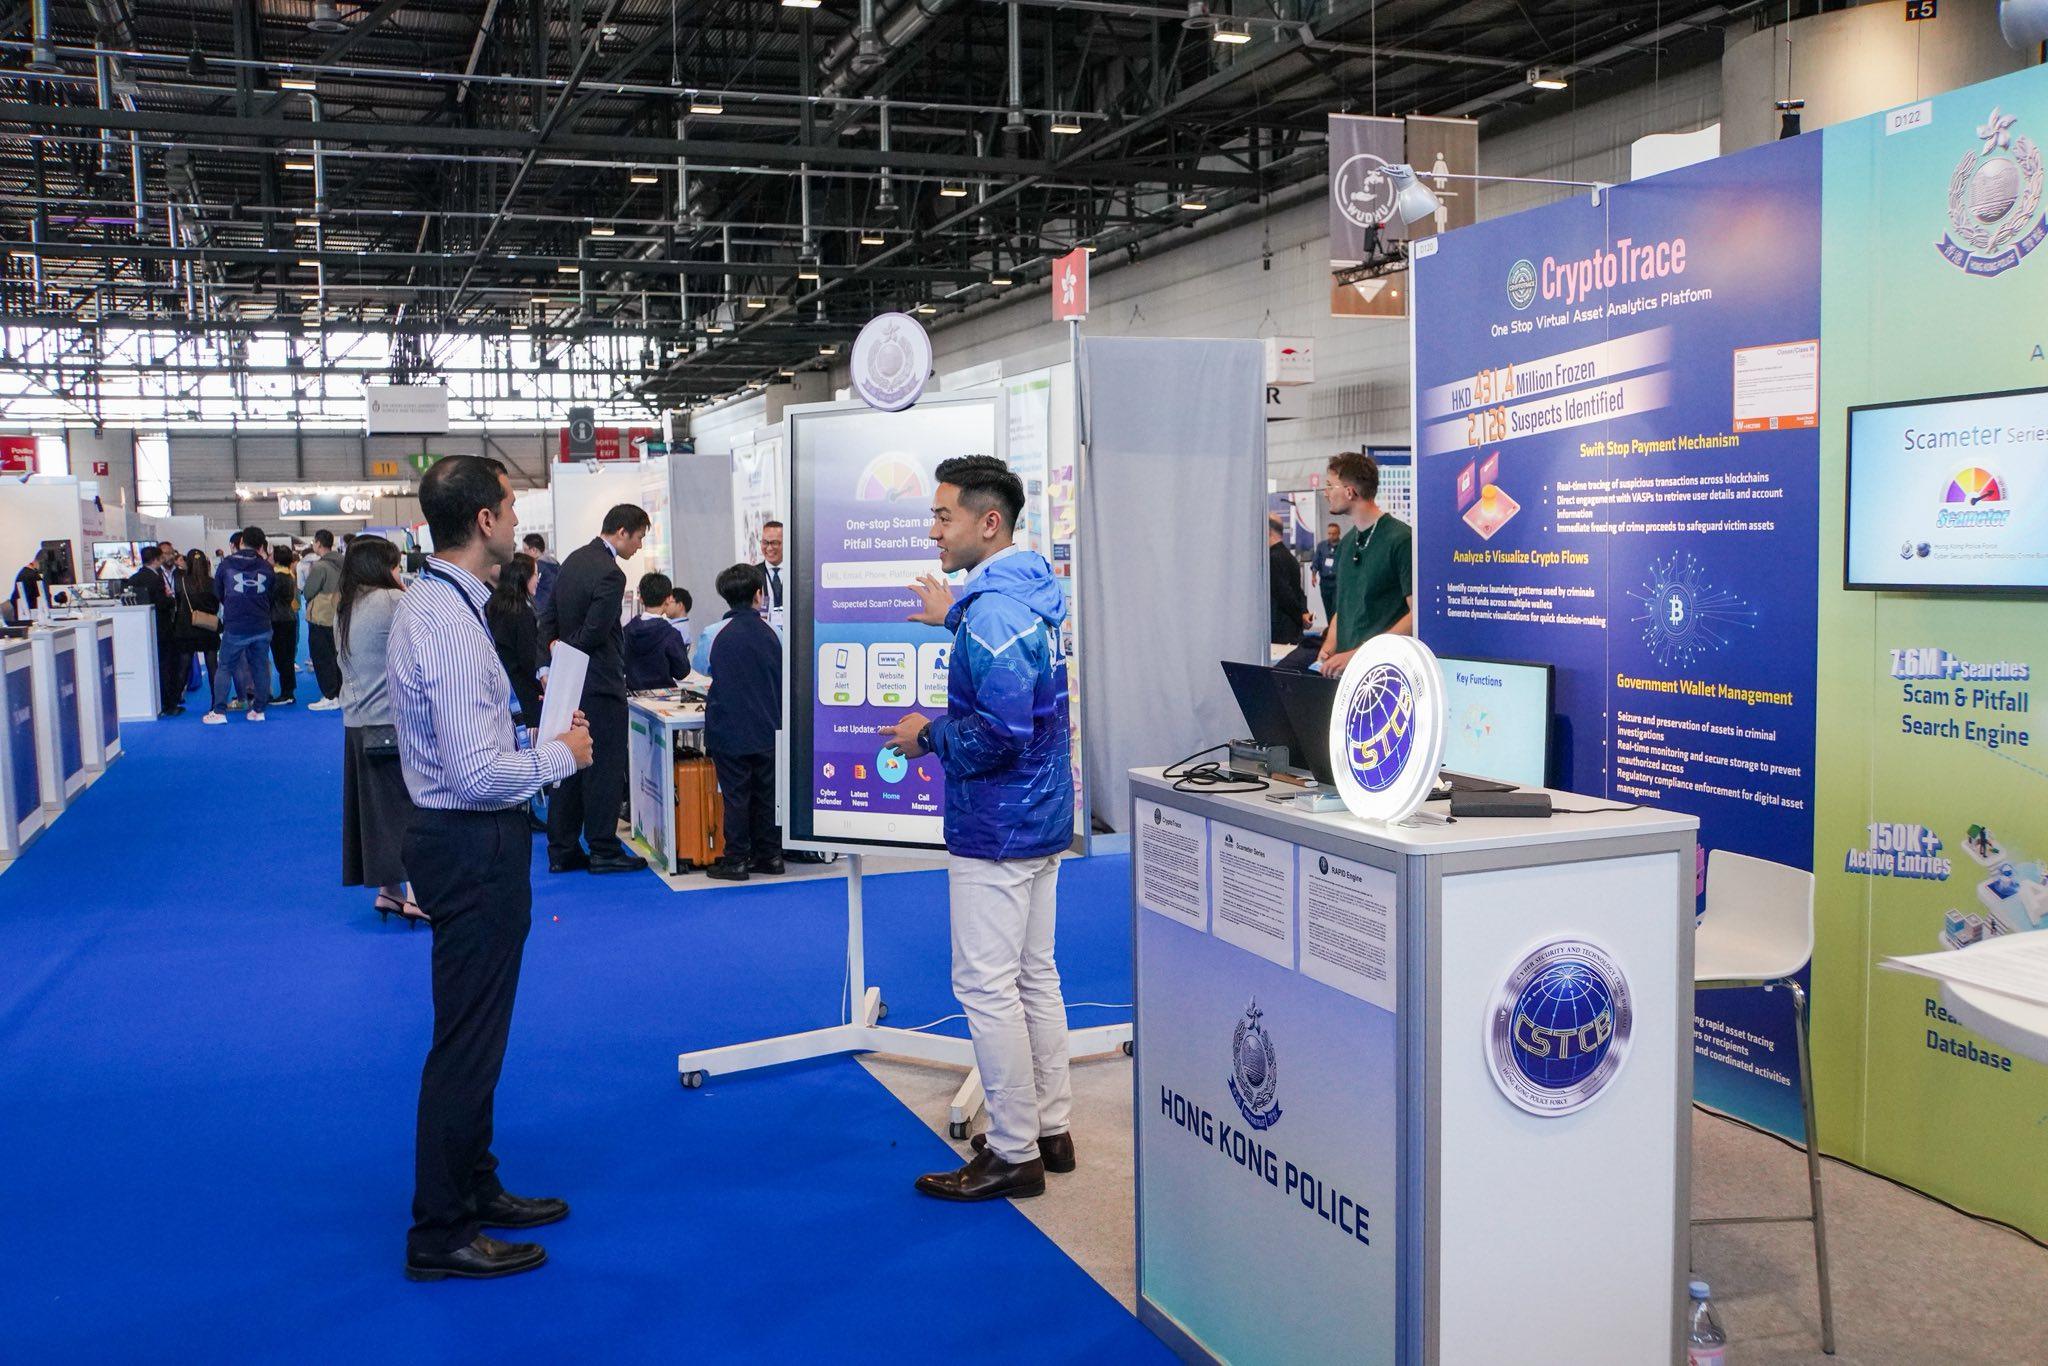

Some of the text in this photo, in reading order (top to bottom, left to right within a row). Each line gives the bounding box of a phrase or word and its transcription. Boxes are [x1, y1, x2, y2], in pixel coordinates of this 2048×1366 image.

[1895, 110, 1921, 128] D122
[1347, 203, 1389, 223] WUDHU
[1541, 238, 1686, 306] CryptoTrace
[1491, 286, 1712, 338] One Stop Virtual Asset Analytics Platform
[2030, 344, 2045, 362] A
[1452, 361, 1596, 411] HKD 431.4 Million Frozen
[1466, 387, 1624, 449] 2,128 Suspects Identified
[1580, 432, 1740, 458] Swift Stop Payment Mechanism
[1904, 424, 2002, 451] Scameter
[97, 463, 105, 473] F
[380, 463, 391, 473] 11
[1557, 472, 1769, 491] Real-time tracing of suspicious transactions across blockchains
[1557, 488, 1783, 505] Direct with VASPs to retrieve user details and account
[1557, 508, 1593, 518] information
[846, 517, 936, 531] One-stop Scam an
[1626, 520, 1775, 534] crime proceeds to safeguard victim assets
[843, 536, 938, 550] Pitfall Search Engin
[1453, 549, 1589, 567] Analyze Visualize Crypto Flows
[1543, 586, 1595, 598] used by criminals
[832, 599, 922, 610] Suspected Scam? Check It
[1490, 599, 1553, 609] across wallets
[1540, 613, 1607, 629] quick decision-making
[835, 671, 848, 679] Call
[879, 672, 905, 680] Website
[1960, 660, 2030, 681] Searches
[834, 682, 850, 690] Alert
[876, 682, 907, 690] Detection
[1456, 672, 1503, 688] Key Functions
[1617, 673, 1793, 706] Government Wallet Management
[1903, 683, 2029, 713] Scam & Pitfall
[833, 725, 849, 733] Last
[849, 725, 876, 734] Update:
[1617, 711, 1776, 741] Seizure and preservation of assets in criminal
[1617, 725, 1664, 741] investigations
[1902, 714, 2029, 748] Search Engine
[1617, 739, 1801, 777] Real-time monitoring and secure storage to prevent
[1617, 755, 1684, 774] unauthorized access
[820, 788, 837, 797] Cyber
[850, 790, 869, 798] Latest
[882, 792, 901, 800] Home
[917, 793, 930, 801] Call
[1617, 768, 1803, 809] Regulatory compliance enforcement for digital asset
[1617, 784, 1661, 799] management
[816, 797, 842, 806] Defender
[852, 799, 869, 807] News
[911, 802, 938, 812] Manager
[1866, 822, 1943, 853] 150K+
[1846, 848, 1951, 881] Active Entries
[1331, 866, 1363, 883] RAPID Engine
[1516, 961, 1535, 980] CYBER
[1536, 947, 1564, 962] SECURITY
[1925, 998, 1962, 1026] Rea
[1513, 1009, 1613, 1059] CSTCB
[1705, 1018, 1774, 1052] rapid asset tracing
[1703, 1033, 1749, 1056] or recipients
[1926, 1030, 2012, 1073] Database
[1695, 1044, 1791, 1086] and coordinated activities
[1161, 1084, 1370, 1246] HONG KONG POLICE
